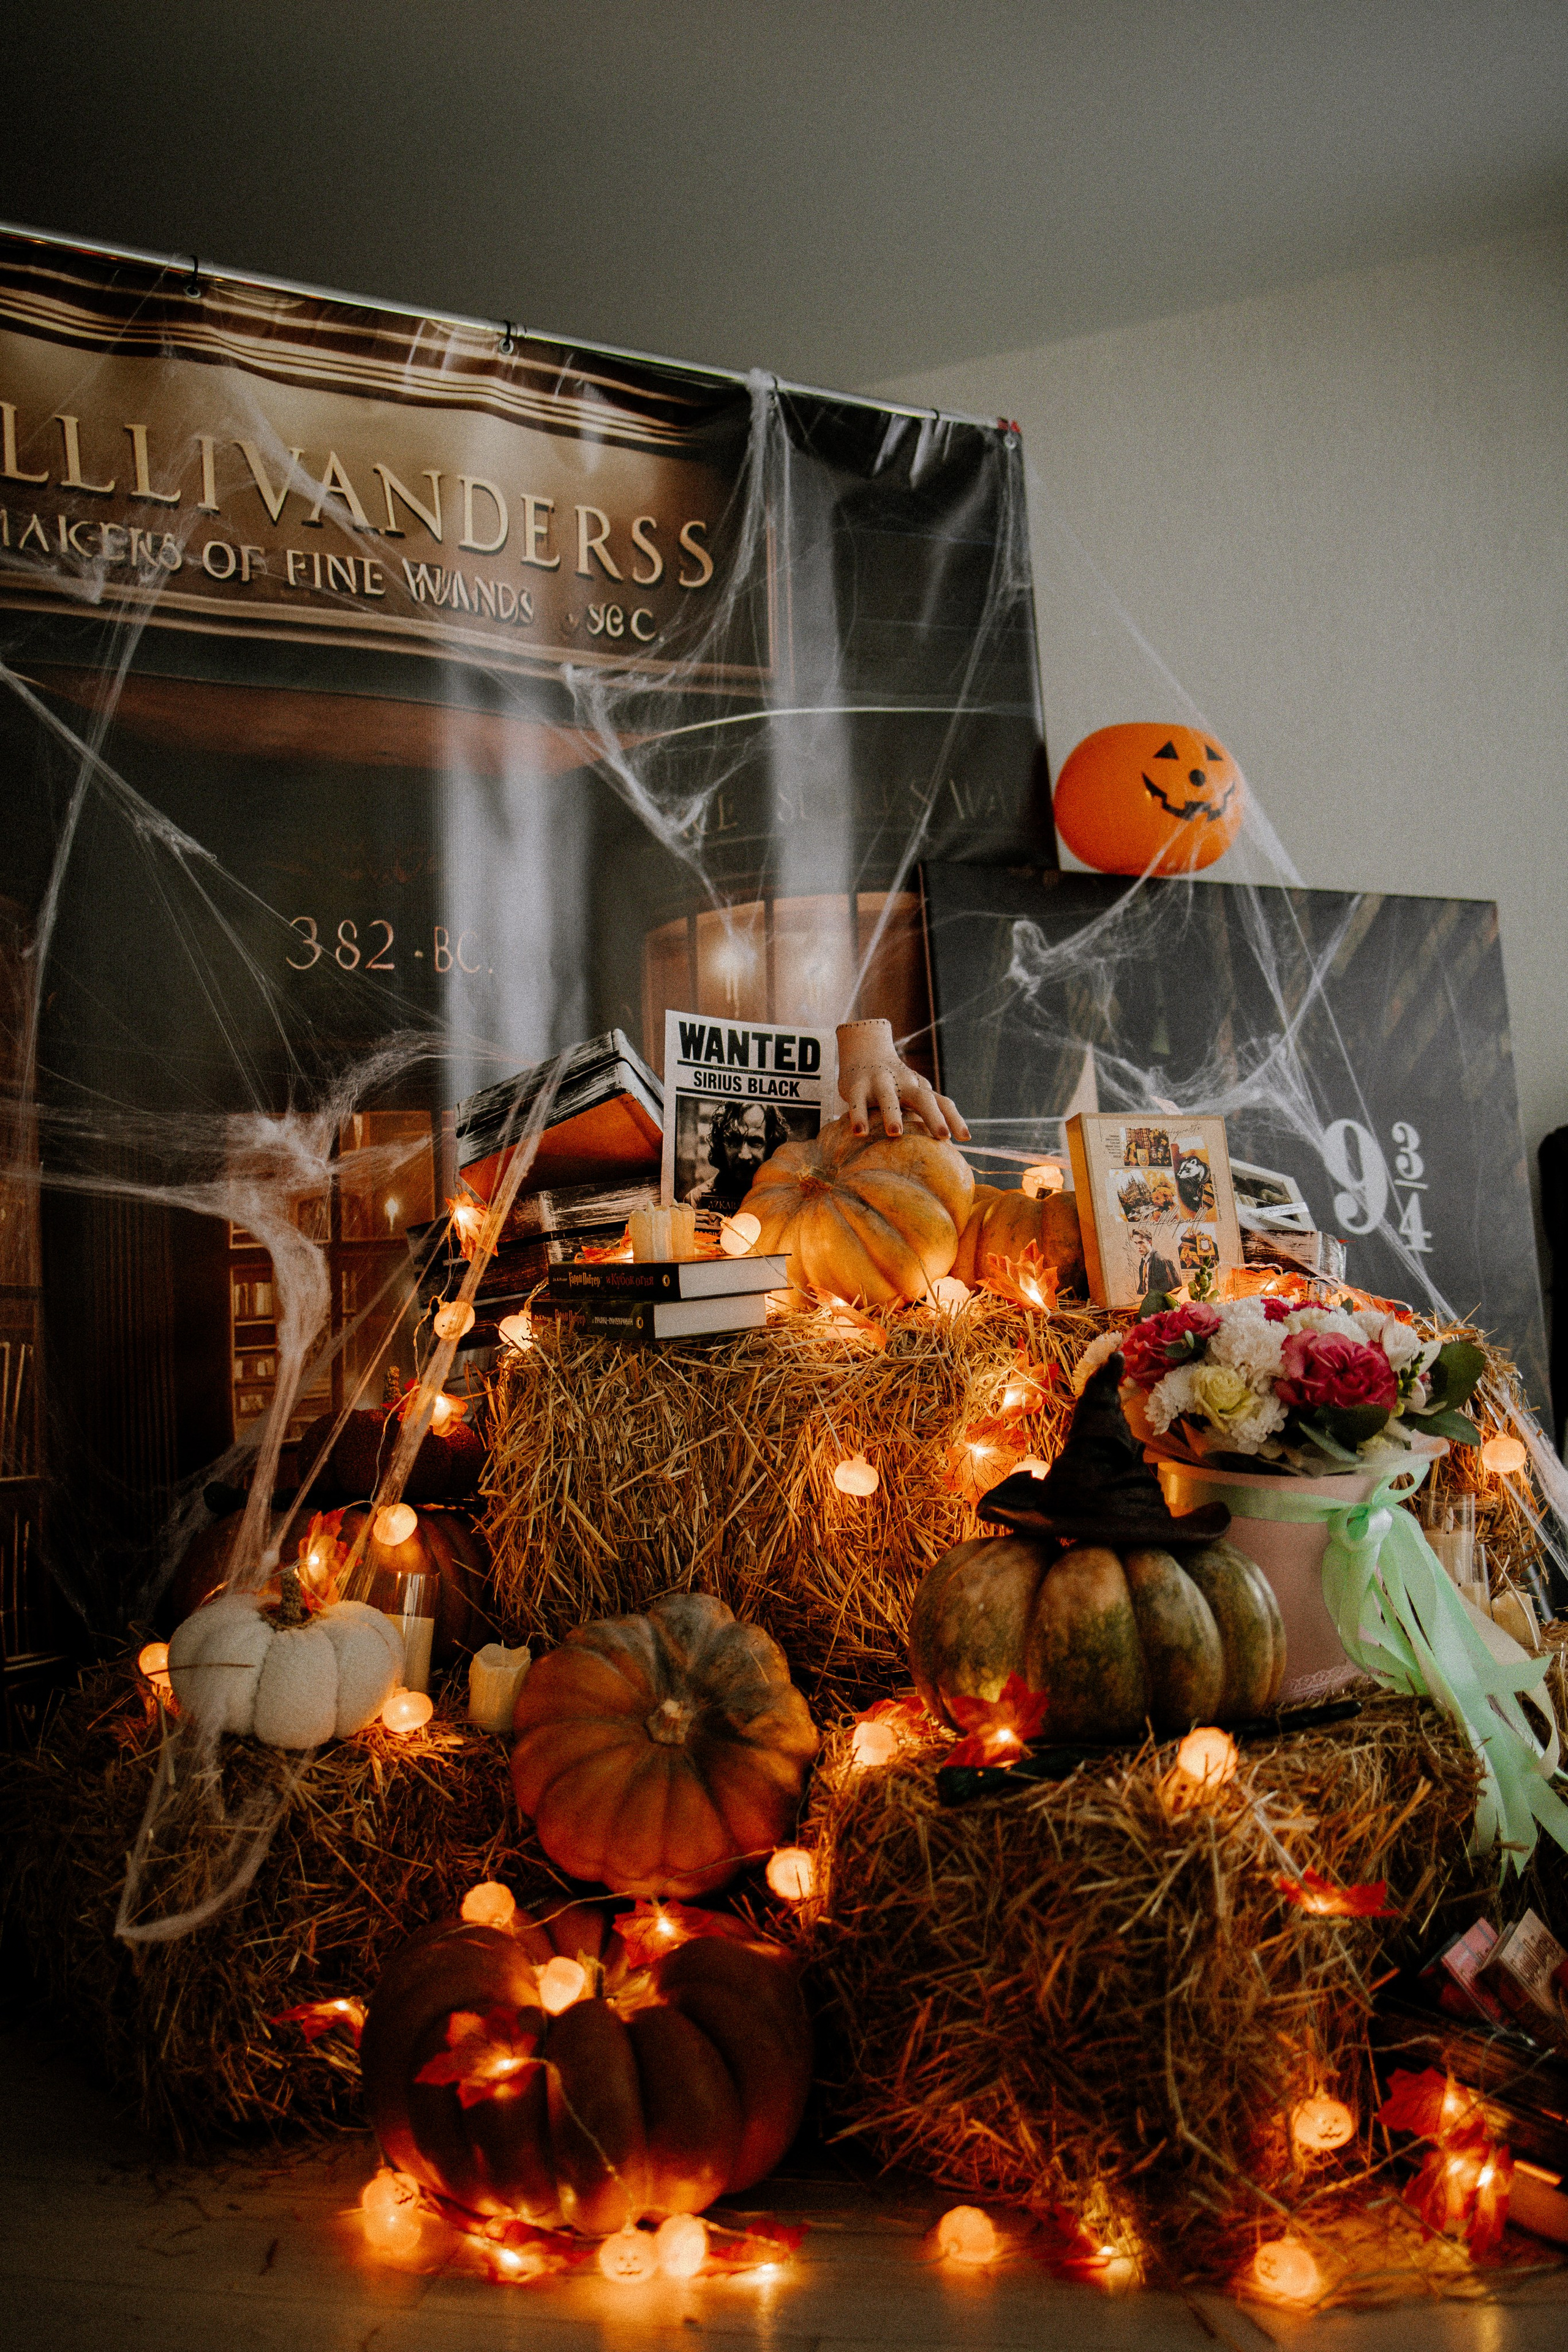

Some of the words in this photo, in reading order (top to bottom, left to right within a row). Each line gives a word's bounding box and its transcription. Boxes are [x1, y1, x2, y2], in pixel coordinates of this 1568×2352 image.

[203, 541, 266, 582] OF
[286, 549, 386, 596] FINE
[678, 1021, 821, 1072] WANTED
[693, 1071, 742, 1092] SIRIUS
[748, 1077, 801, 1097] BLACK
[1138, 1205, 1208, 1238] Hufflepuff
[568, 1272, 582, 1288] Гарри
[582, 1272, 601, 1287] Поттер
